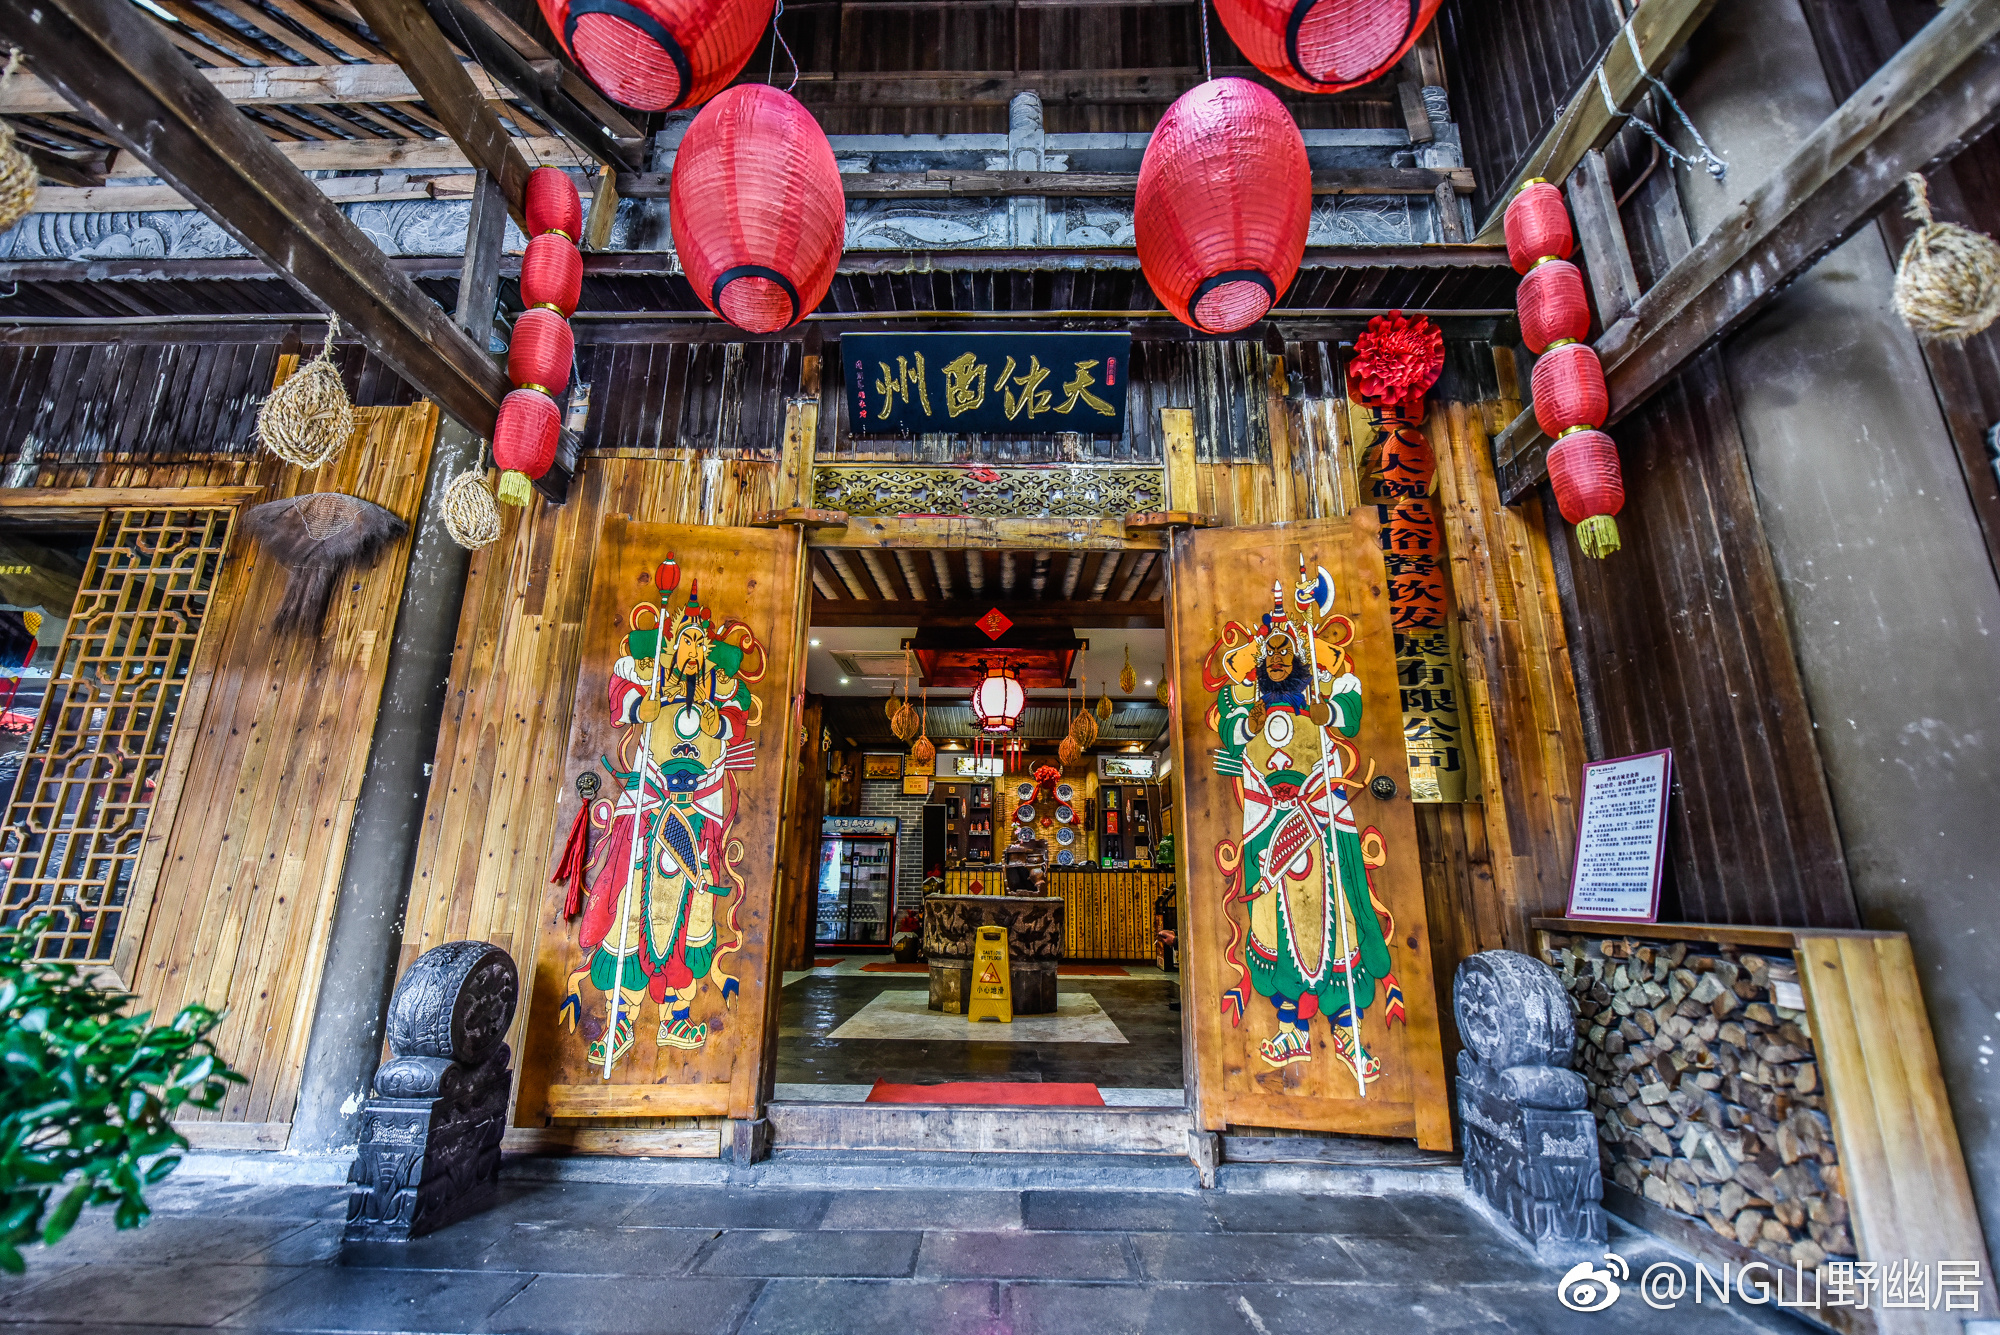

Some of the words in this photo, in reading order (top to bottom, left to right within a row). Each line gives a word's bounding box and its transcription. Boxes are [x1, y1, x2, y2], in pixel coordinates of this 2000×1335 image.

[1362, 394, 1462, 773] 县八大碗民俗餐饮发展有限公司
[977, 986, 1004, 994] 小心地滑
